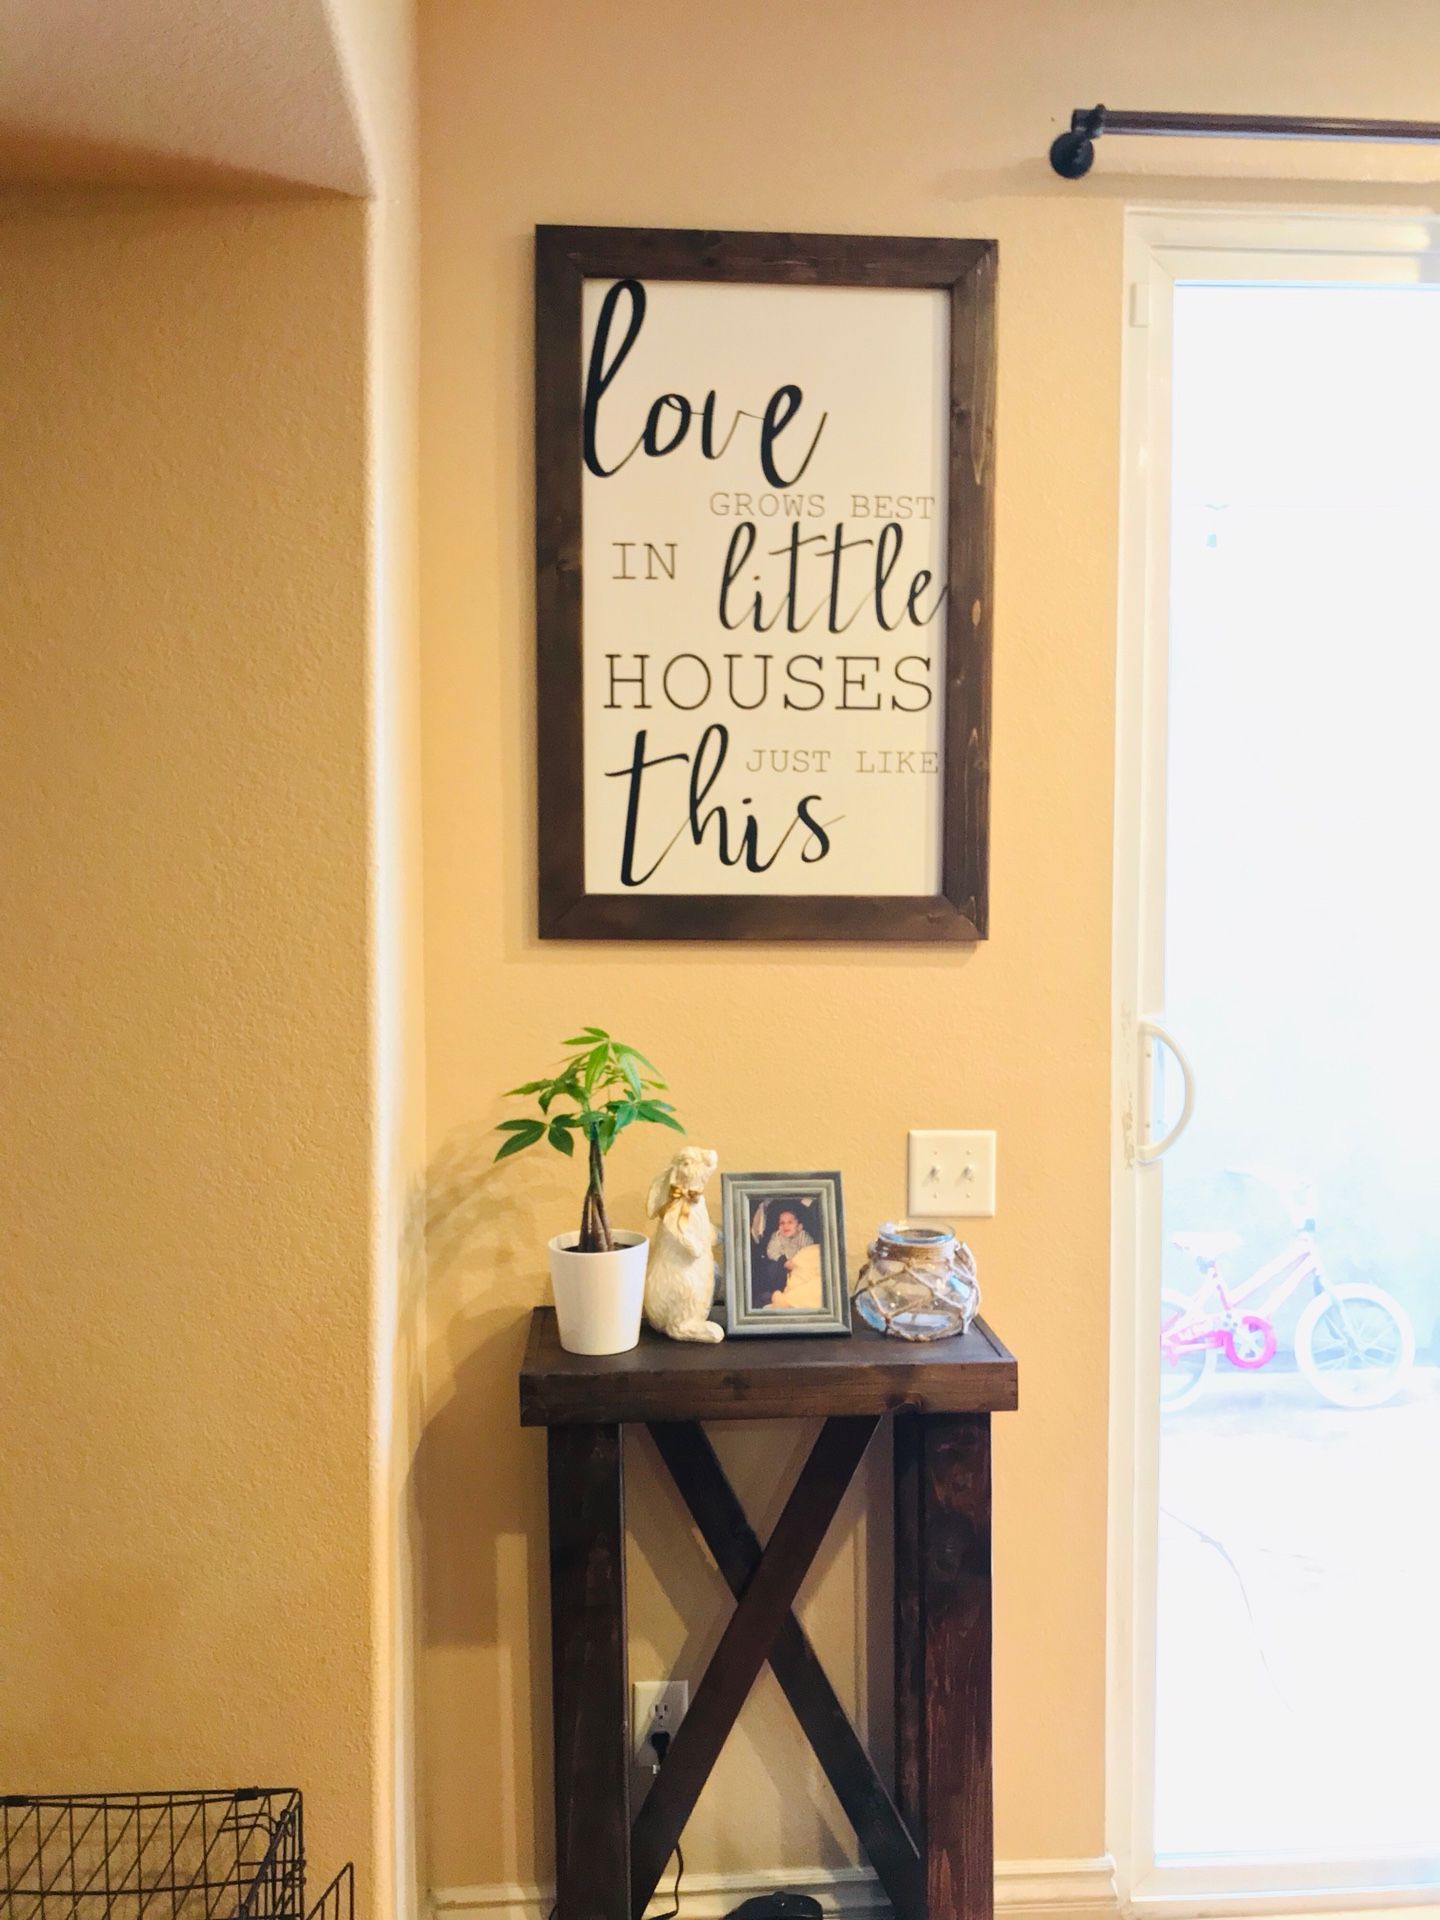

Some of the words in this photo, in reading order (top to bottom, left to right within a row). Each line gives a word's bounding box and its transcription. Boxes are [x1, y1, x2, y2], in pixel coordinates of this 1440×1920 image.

[582, 279, 827, 488] love
[709, 492, 826, 518] GROWS
[851, 494, 936, 519] BEST
[612, 542, 678, 580] IN
[718, 521, 949, 634] little
[603, 653, 933, 712] HOUSES
[604, 723, 847, 886] this
[746, 749, 831, 773] JUST
[856, 750, 939, 774] LIKE
